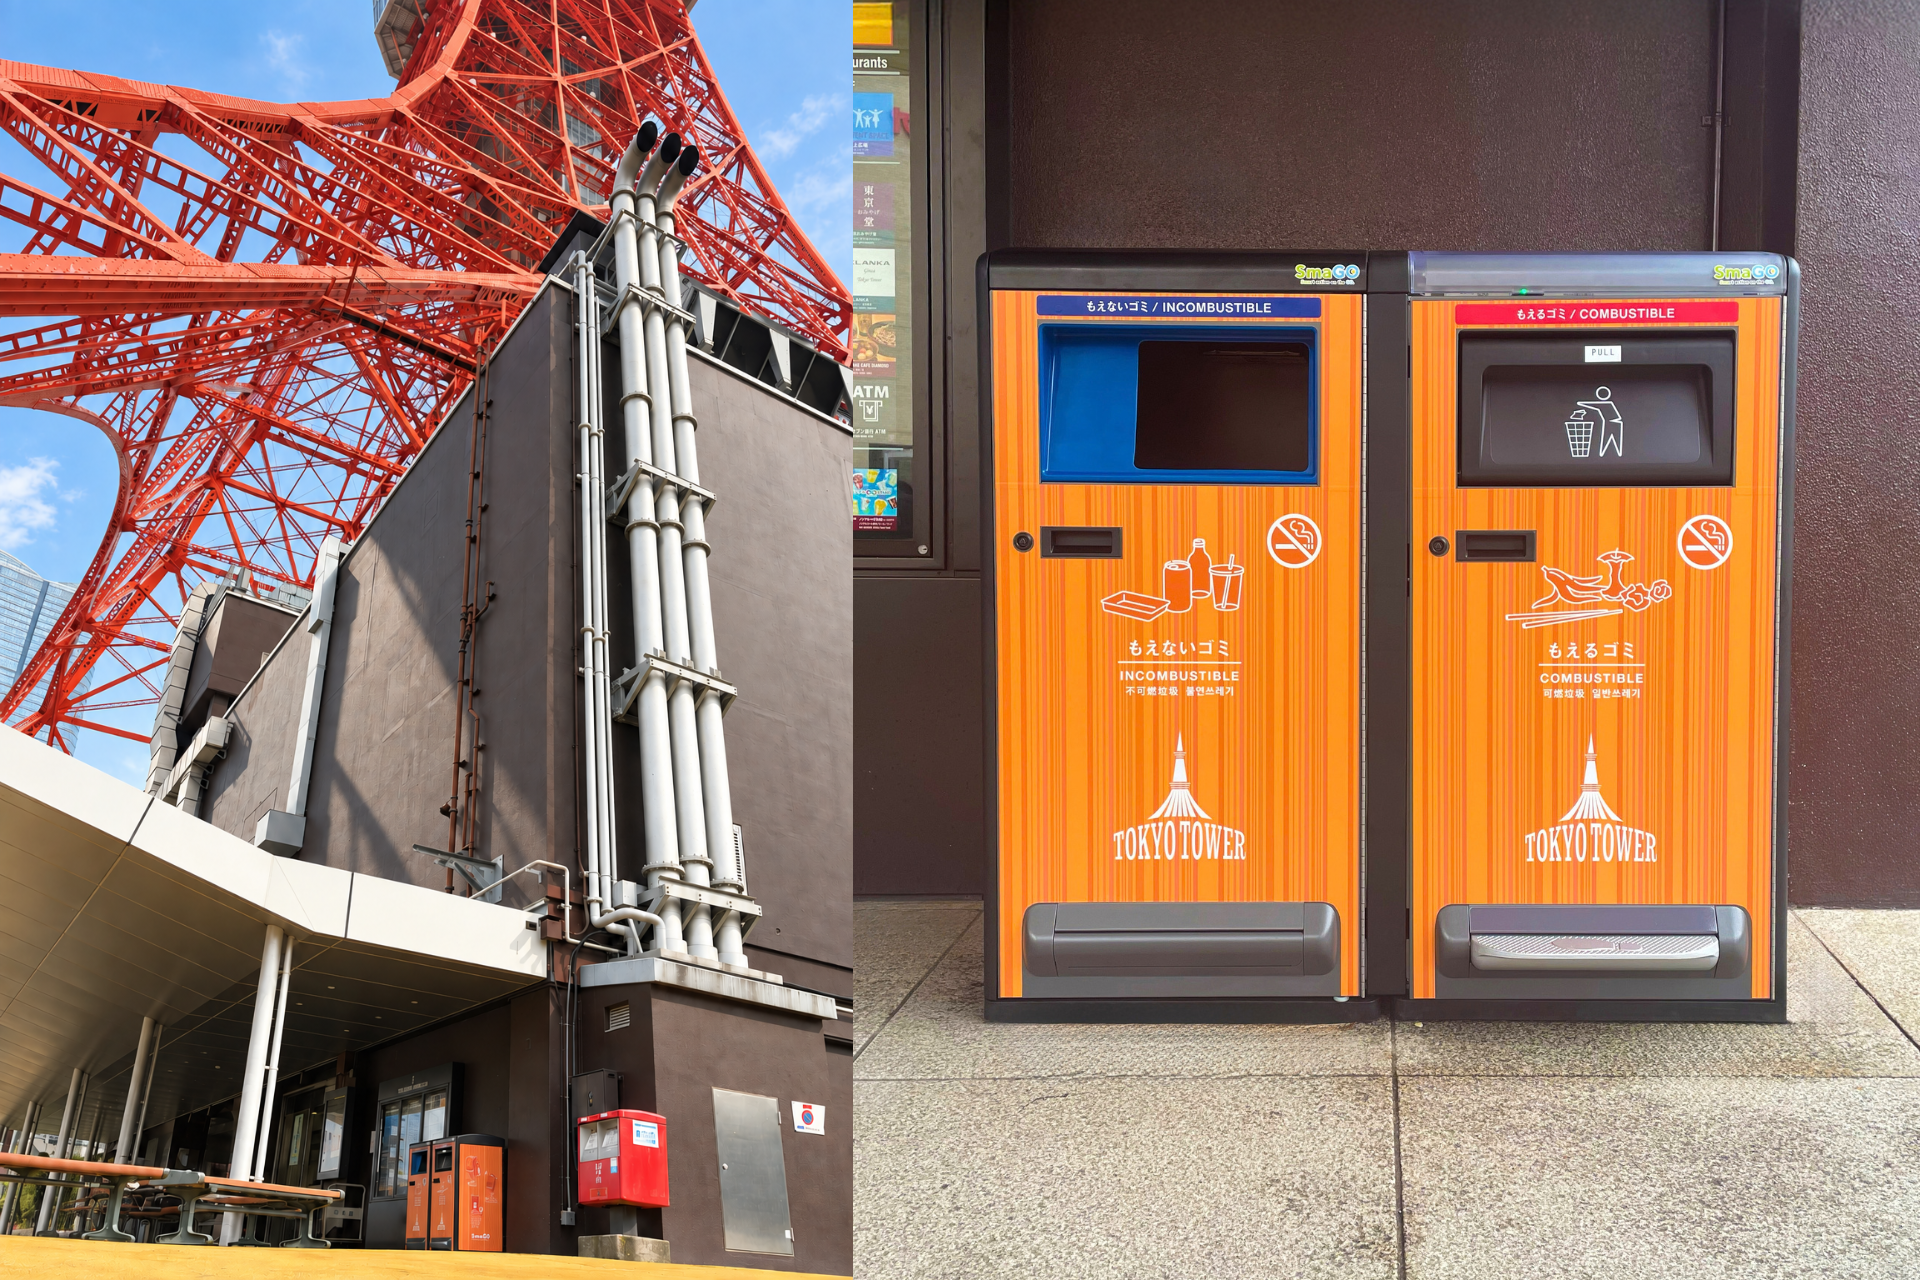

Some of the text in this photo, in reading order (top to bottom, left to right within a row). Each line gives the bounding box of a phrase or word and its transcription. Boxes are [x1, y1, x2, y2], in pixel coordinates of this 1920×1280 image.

[1294, 264, 1360, 279] SmaGO
[1713, 264, 1779, 279] SmaGO
[1086, 300, 1148, 313] もえないゴミ
[1162, 302, 1272, 313] INCOMBUSTIBLE
[1516, 308, 1566, 320] もえるゴミ
[1579, 307, 1675, 320] COMBUSTIBLE
[1591, 348, 1615, 356] PULL
[853, 385, 889, 398] ATM
[1129, 639, 1229, 657] もえないゴミ
[1549, 642, 1634, 659] もえるゴミ
[1119, 670, 1239, 681] INCOMBUSTIBLE
[1540, 673, 1644, 684] COMBUSTIBLE
[1125, 686, 1179, 696] 不可燃垃圾
[1543, 688, 1641, 699] 可燃垃圾 일반쓰레기
[1113, 820, 1247, 861] TOKYO TOWER
[1525, 822, 1658, 863] TOKYO TOWER
